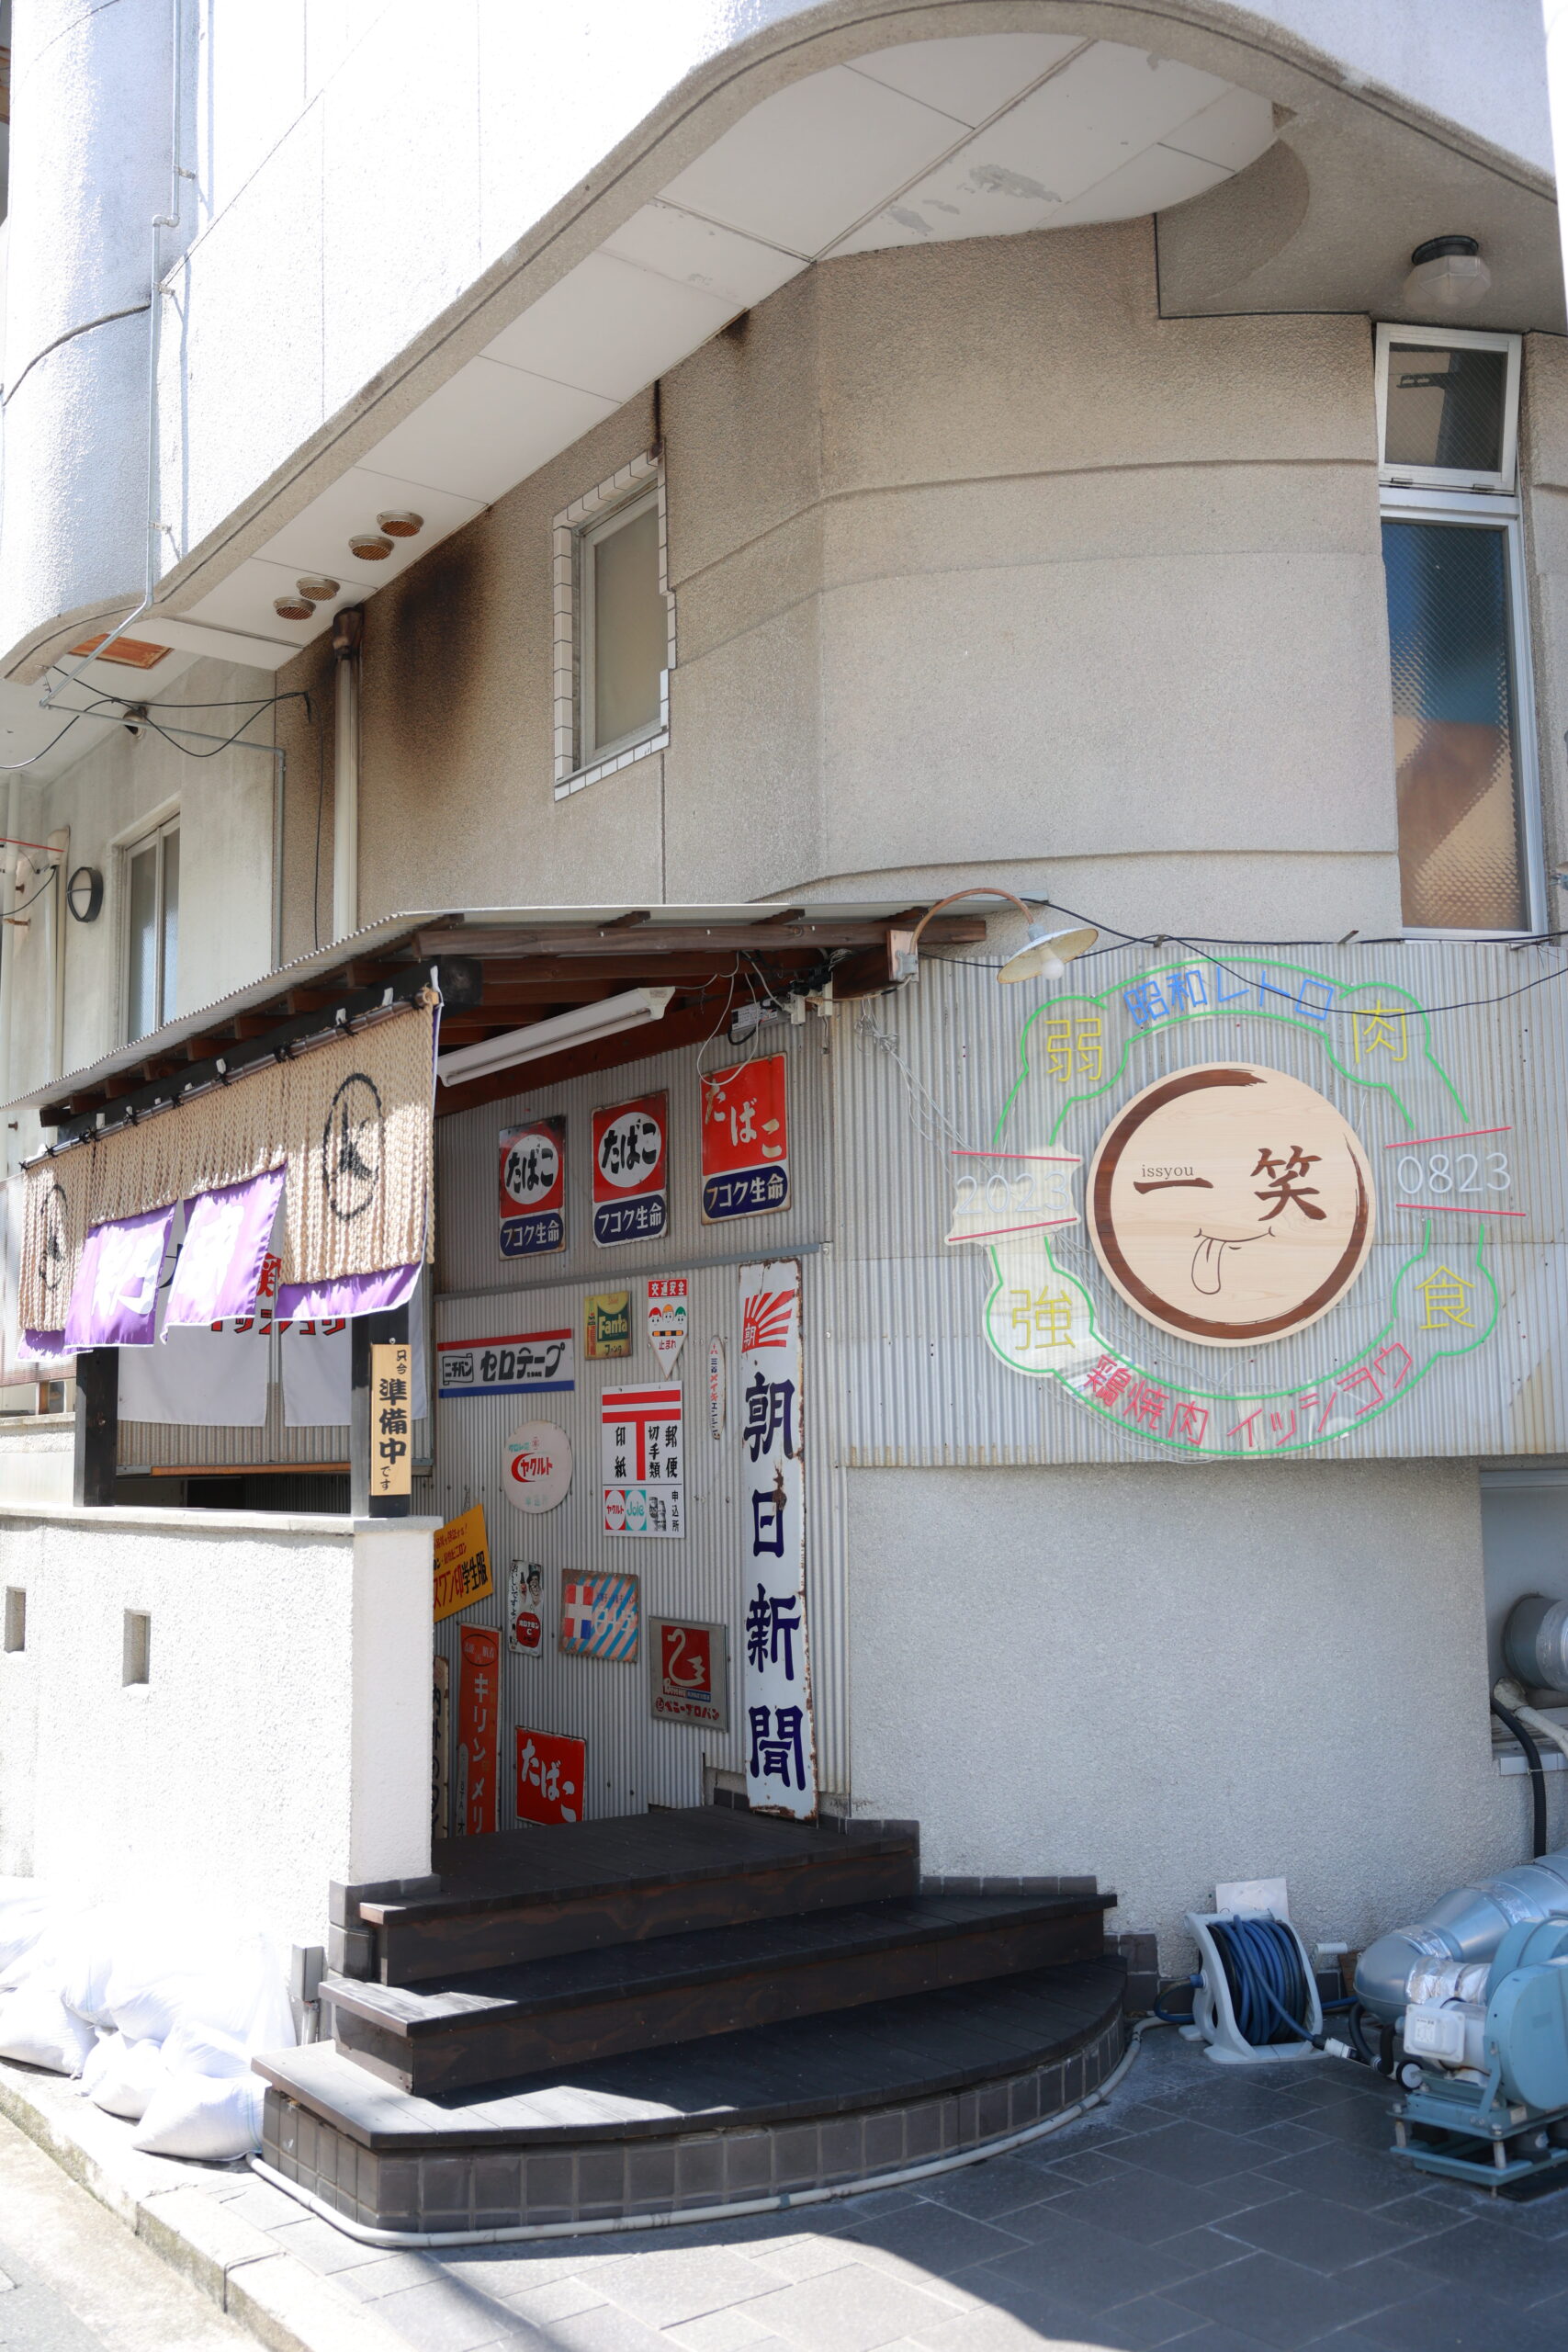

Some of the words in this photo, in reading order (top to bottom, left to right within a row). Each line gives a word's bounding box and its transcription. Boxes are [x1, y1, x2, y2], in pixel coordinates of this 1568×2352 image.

[1123, 966, 1335, 1025] 昭和レトロ
[1044, 1018, 1102, 1082] 弱
[1352, 1000, 1407, 1064] 肉
[705, 1079, 783, 1159] たばこ
[506, 1143, 554, 1193] たばこ
[602, 1118, 658, 1174] たばこ
[706, 1173, 784, 1211] フコク生命
[956, 1170, 1070, 1215] 2023
[1133, 1145, 1327, 1222] 一笑
[1142, 1164, 1194, 1180] issyou
[1397, 1152, 1511, 1194] 0823
[503, 1219, 560, 1248] フコク生命
[598, 1202, 662, 1237] フコク生命
[651, 1281, 684, 1296] 交通安全
[1415, 1265, 1475, 1329] 食
[598, 1314, 628, 1340] Fanta
[744, 1325, 756, 1346] 朝
[1010, 1285, 1076, 1350] 強
[480, 1341, 566, 1382] セロテープ
[659, 1340, 676, 1351] 止まれ
[445, 1361, 472, 1378] ニチバン
[520, 1456, 553, 1477] ヤクルト
[615, 1426, 626, 1478] 印紙
[649, 1425, 660, 1478] 切手類
[665, 1425, 678, 1478] 郵便
[606, 1505, 625, 1515] ヤクルト
[626, 1501, 645, 1516] Joie
[743, 1372, 807, 1792] 朝日新聞
[521, 1738, 577, 1823] たばこ
